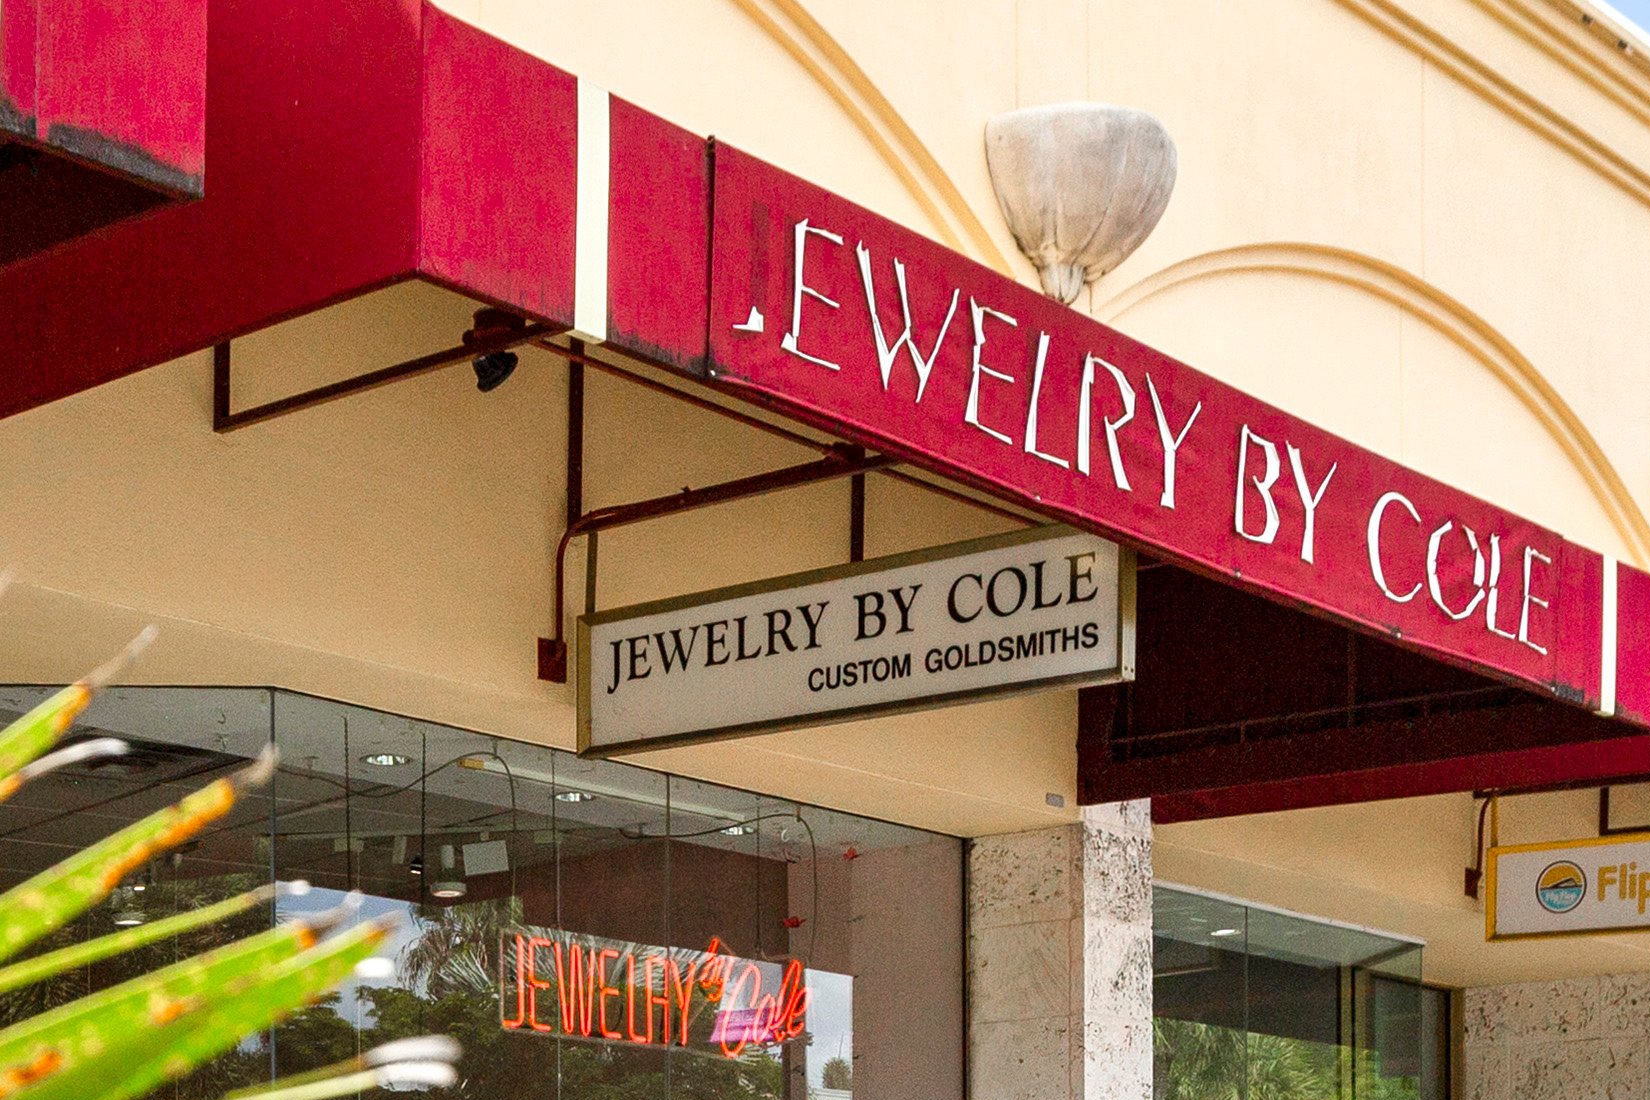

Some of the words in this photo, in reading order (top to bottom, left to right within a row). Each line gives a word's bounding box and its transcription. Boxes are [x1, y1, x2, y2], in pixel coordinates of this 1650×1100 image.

[732, 218, 1201, 509] EWELRY
[1235, 424, 1337, 564] BY
[1367, 491, 1551, 655] COLE
[607, 601, 830, 694] JEWELRY
[854, 583, 923, 642] BY
[947, 551, 1099, 624] COLE
[808, 654, 912, 692] CUSTOM
[925, 622, 1100, 674] GOLDSMITHS
